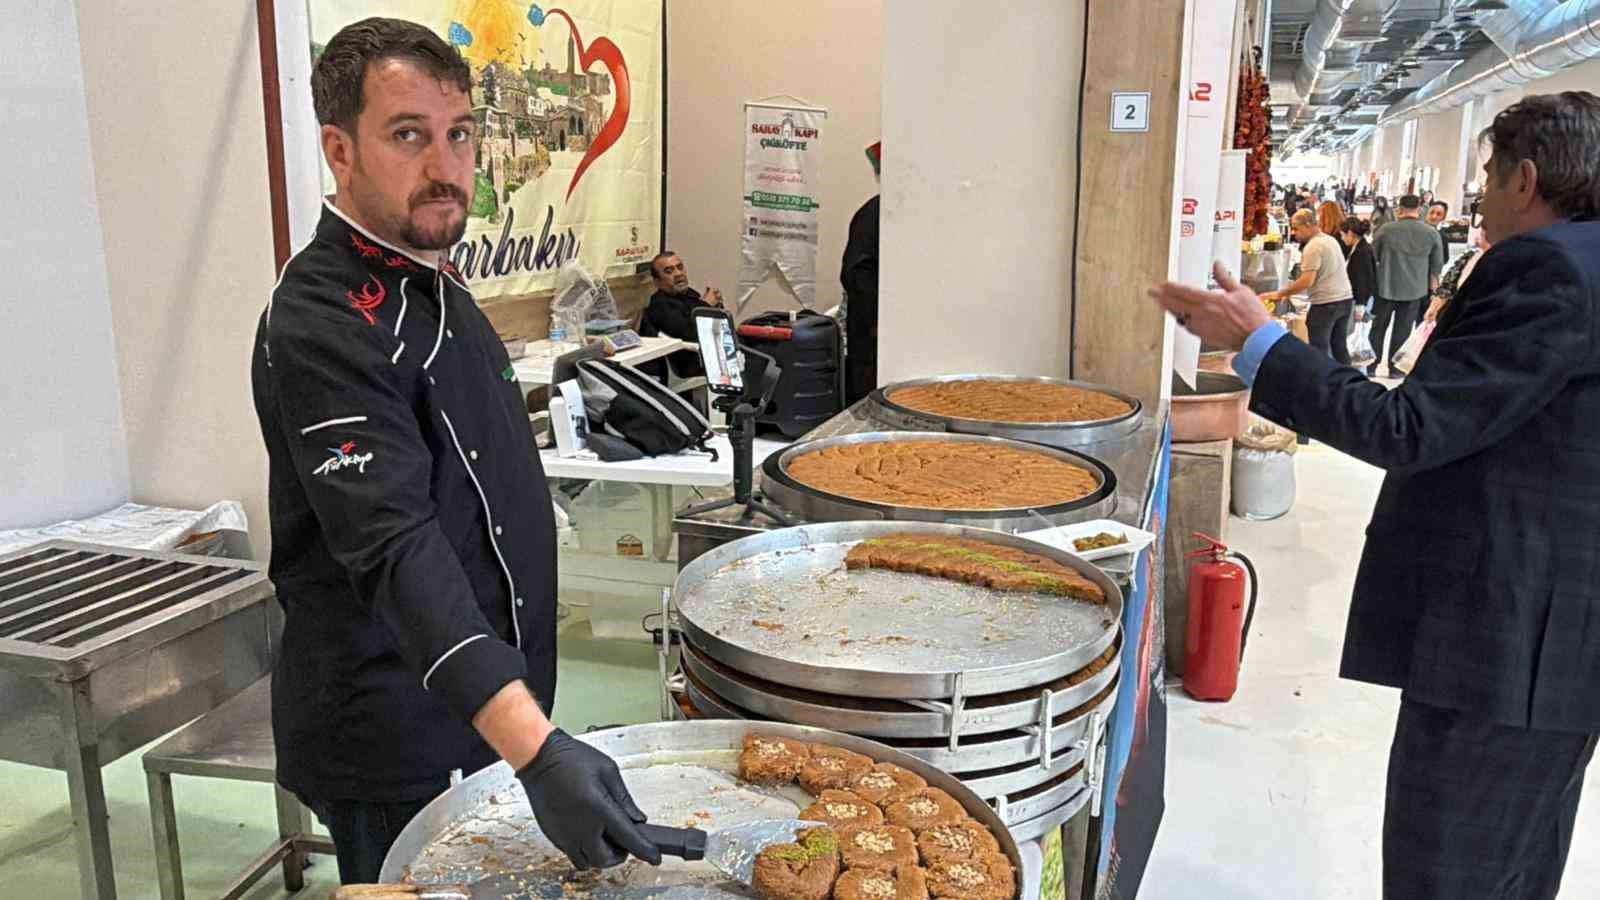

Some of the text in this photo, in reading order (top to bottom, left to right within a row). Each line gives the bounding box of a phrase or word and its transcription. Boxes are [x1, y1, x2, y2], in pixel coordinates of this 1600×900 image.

[1124, 104, 1136, 120] 2
[1215, 210, 1236, 221] API
[453, 205, 581, 279] arbakır
